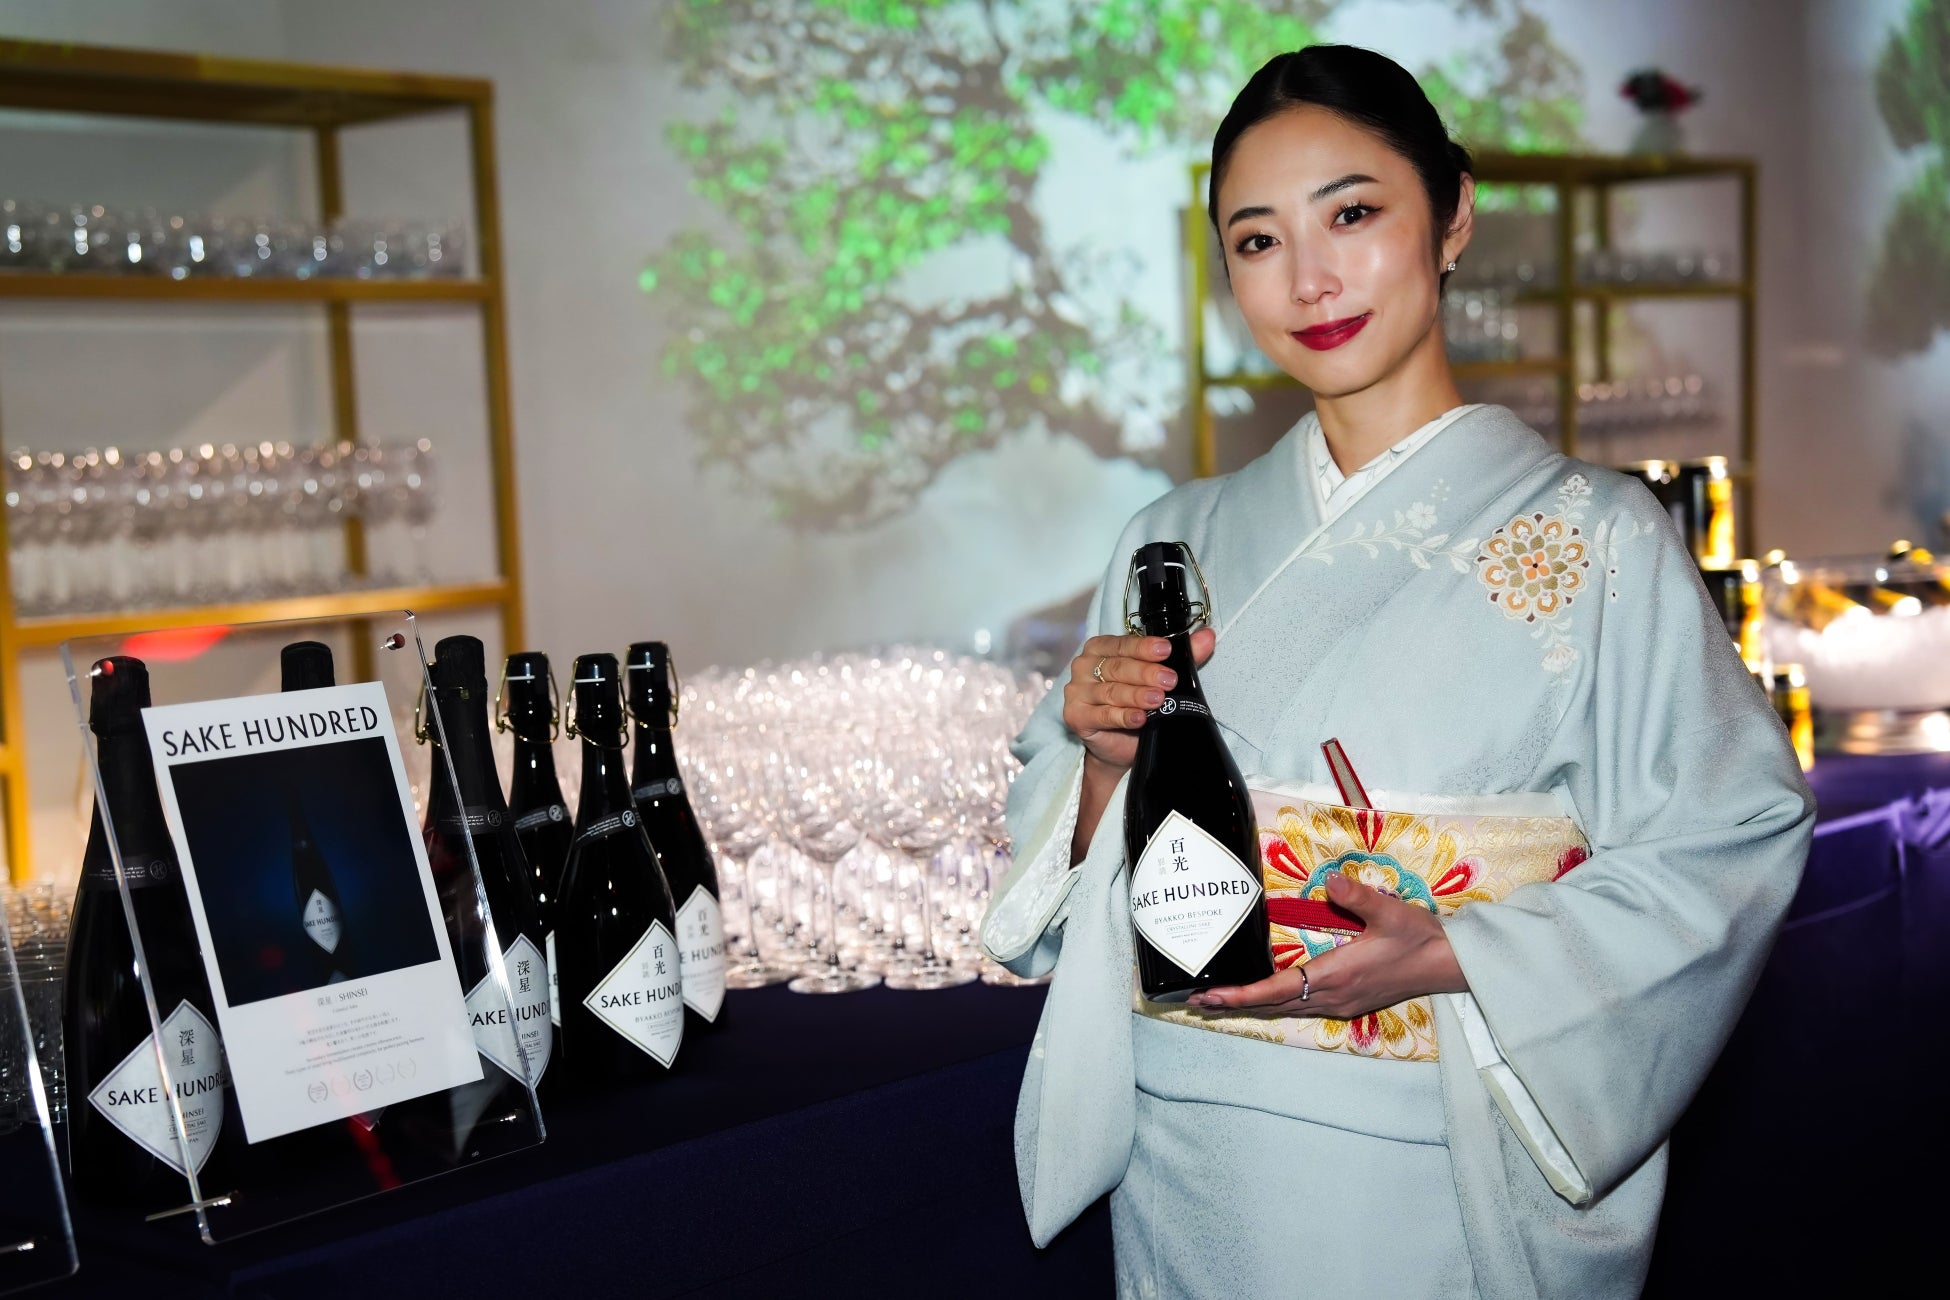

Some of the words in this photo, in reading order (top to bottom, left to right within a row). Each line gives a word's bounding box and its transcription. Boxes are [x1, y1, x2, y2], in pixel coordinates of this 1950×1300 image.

[162, 724, 236, 757] SAKE
[243, 706, 378, 747] HUNDRED
[1169, 837, 1189, 873] 百光
[1132, 891, 1159, 911] SAKE
[1164, 880, 1250, 902] HUNDRED
[1154, 914, 1185, 925] BYAKKO
[1187, 908, 1223, 919] BESPOKE
[653, 944, 666, 976] 百光
[517, 960, 530, 993] 深星
[338, 987, 368, 1001] SHINSEI
[601, 991, 641, 1008] SAKE
[647, 980, 681, 1003] HUND
[468, 1009, 507, 1026] AKE
[179, 1029, 195, 1067] 深星
[108, 1087, 158, 1106] SAKE
